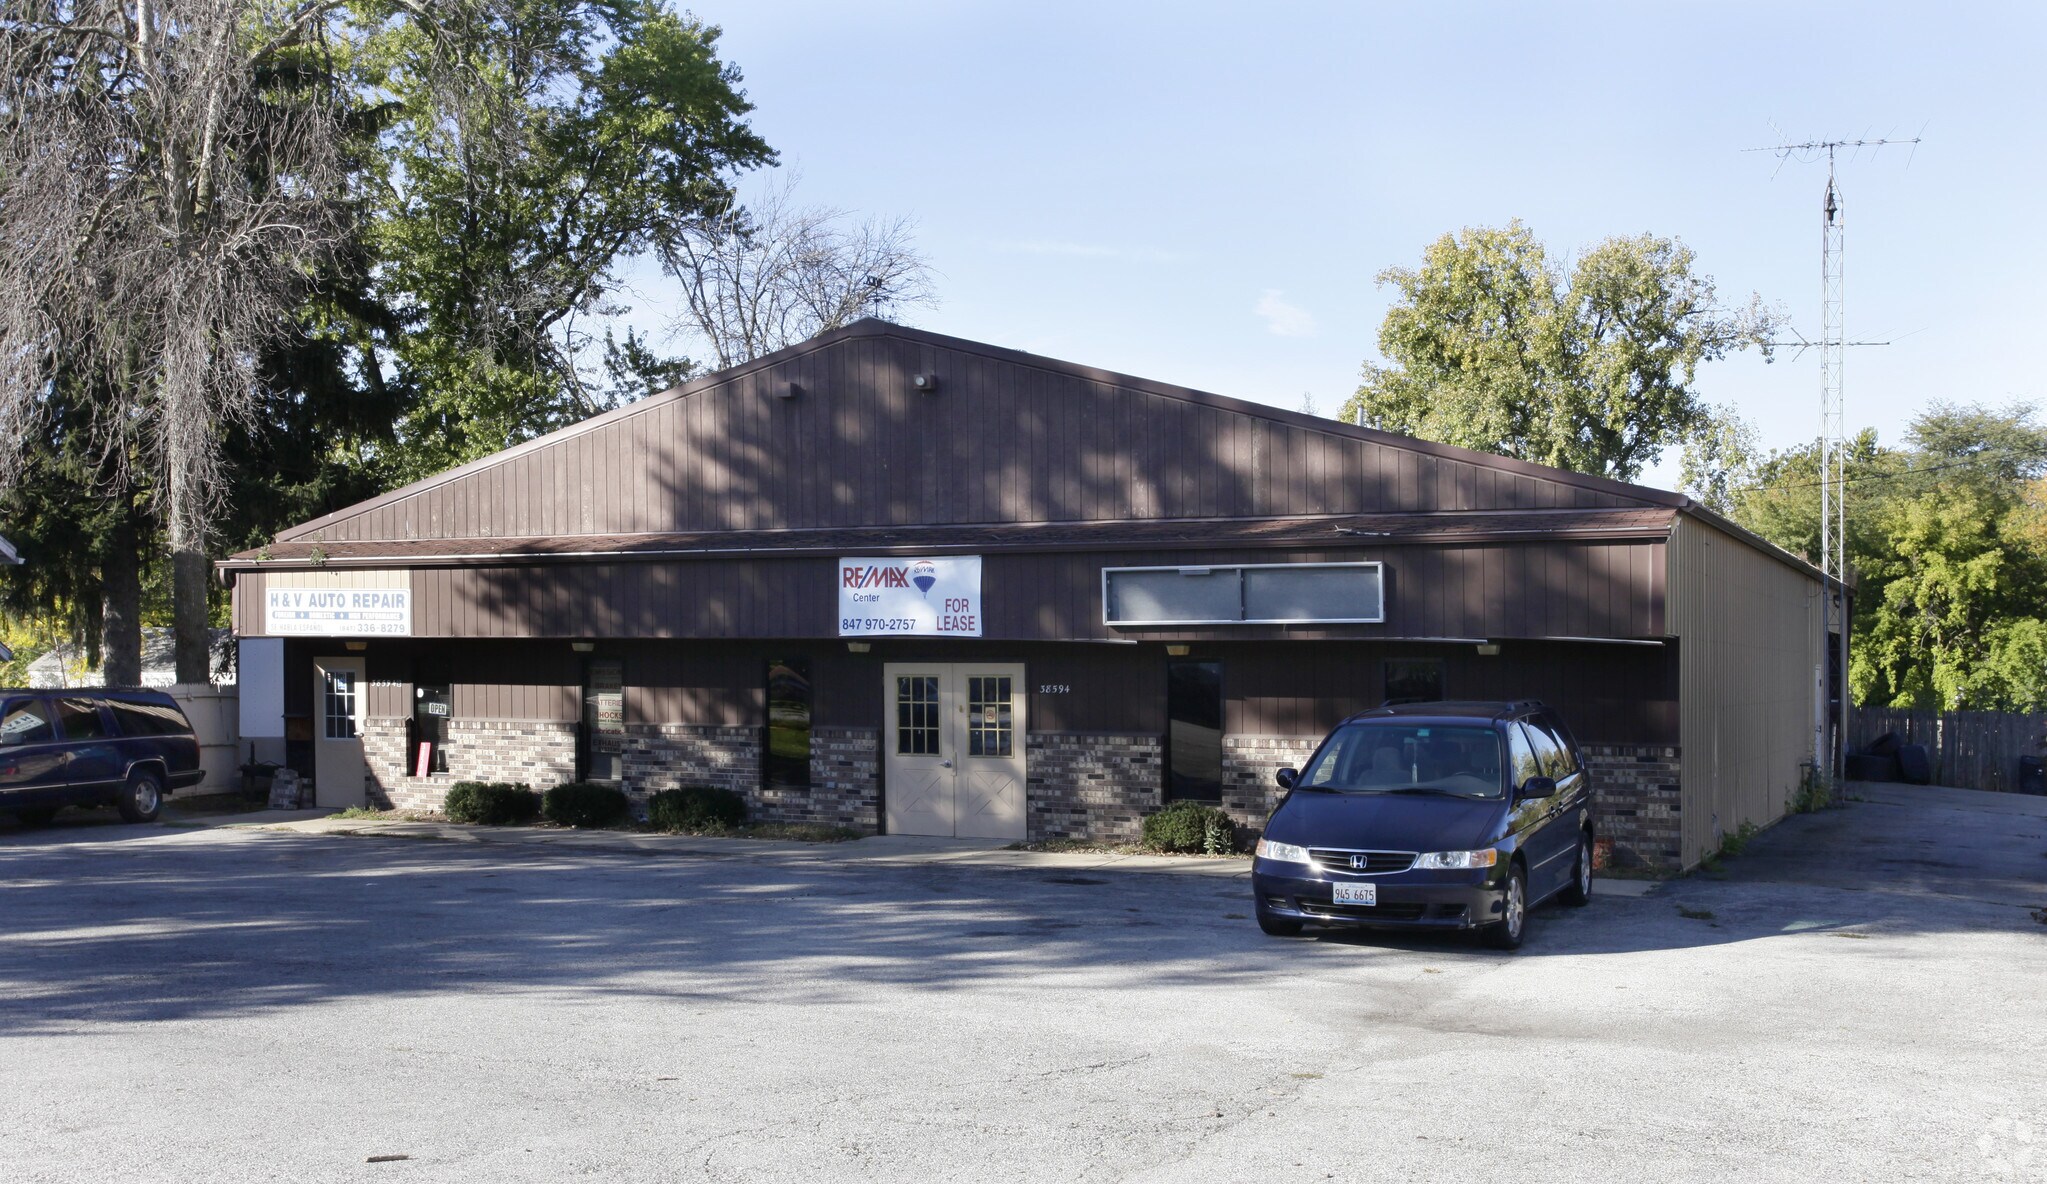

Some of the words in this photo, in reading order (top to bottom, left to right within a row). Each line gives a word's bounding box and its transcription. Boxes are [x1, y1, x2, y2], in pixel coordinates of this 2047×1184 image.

[843, 566, 910, 589] RE/MAX
[270, 593, 278, 607] H
[282, 593, 290, 607] &
[293, 593, 302, 607] V
[308, 593, 346, 608] AUTO
[352, 593, 405, 608] REPAIR
[853, 593, 880, 602] Center
[945, 598, 969, 613] FOR
[357, 623, 406, 633] 336-8279
[842, 619, 862, 630] 847
[865, 618, 916, 630] 970-2757
[937, 615, 975, 631] LEASE
[1040, 684, 1070, 694] 38594
[430, 703, 446, 714] OPEN
[593, 739, 621, 747] EXHAUS
[1335, 888, 1350, 900] 945
[1354, 889, 1374, 901] 6675
